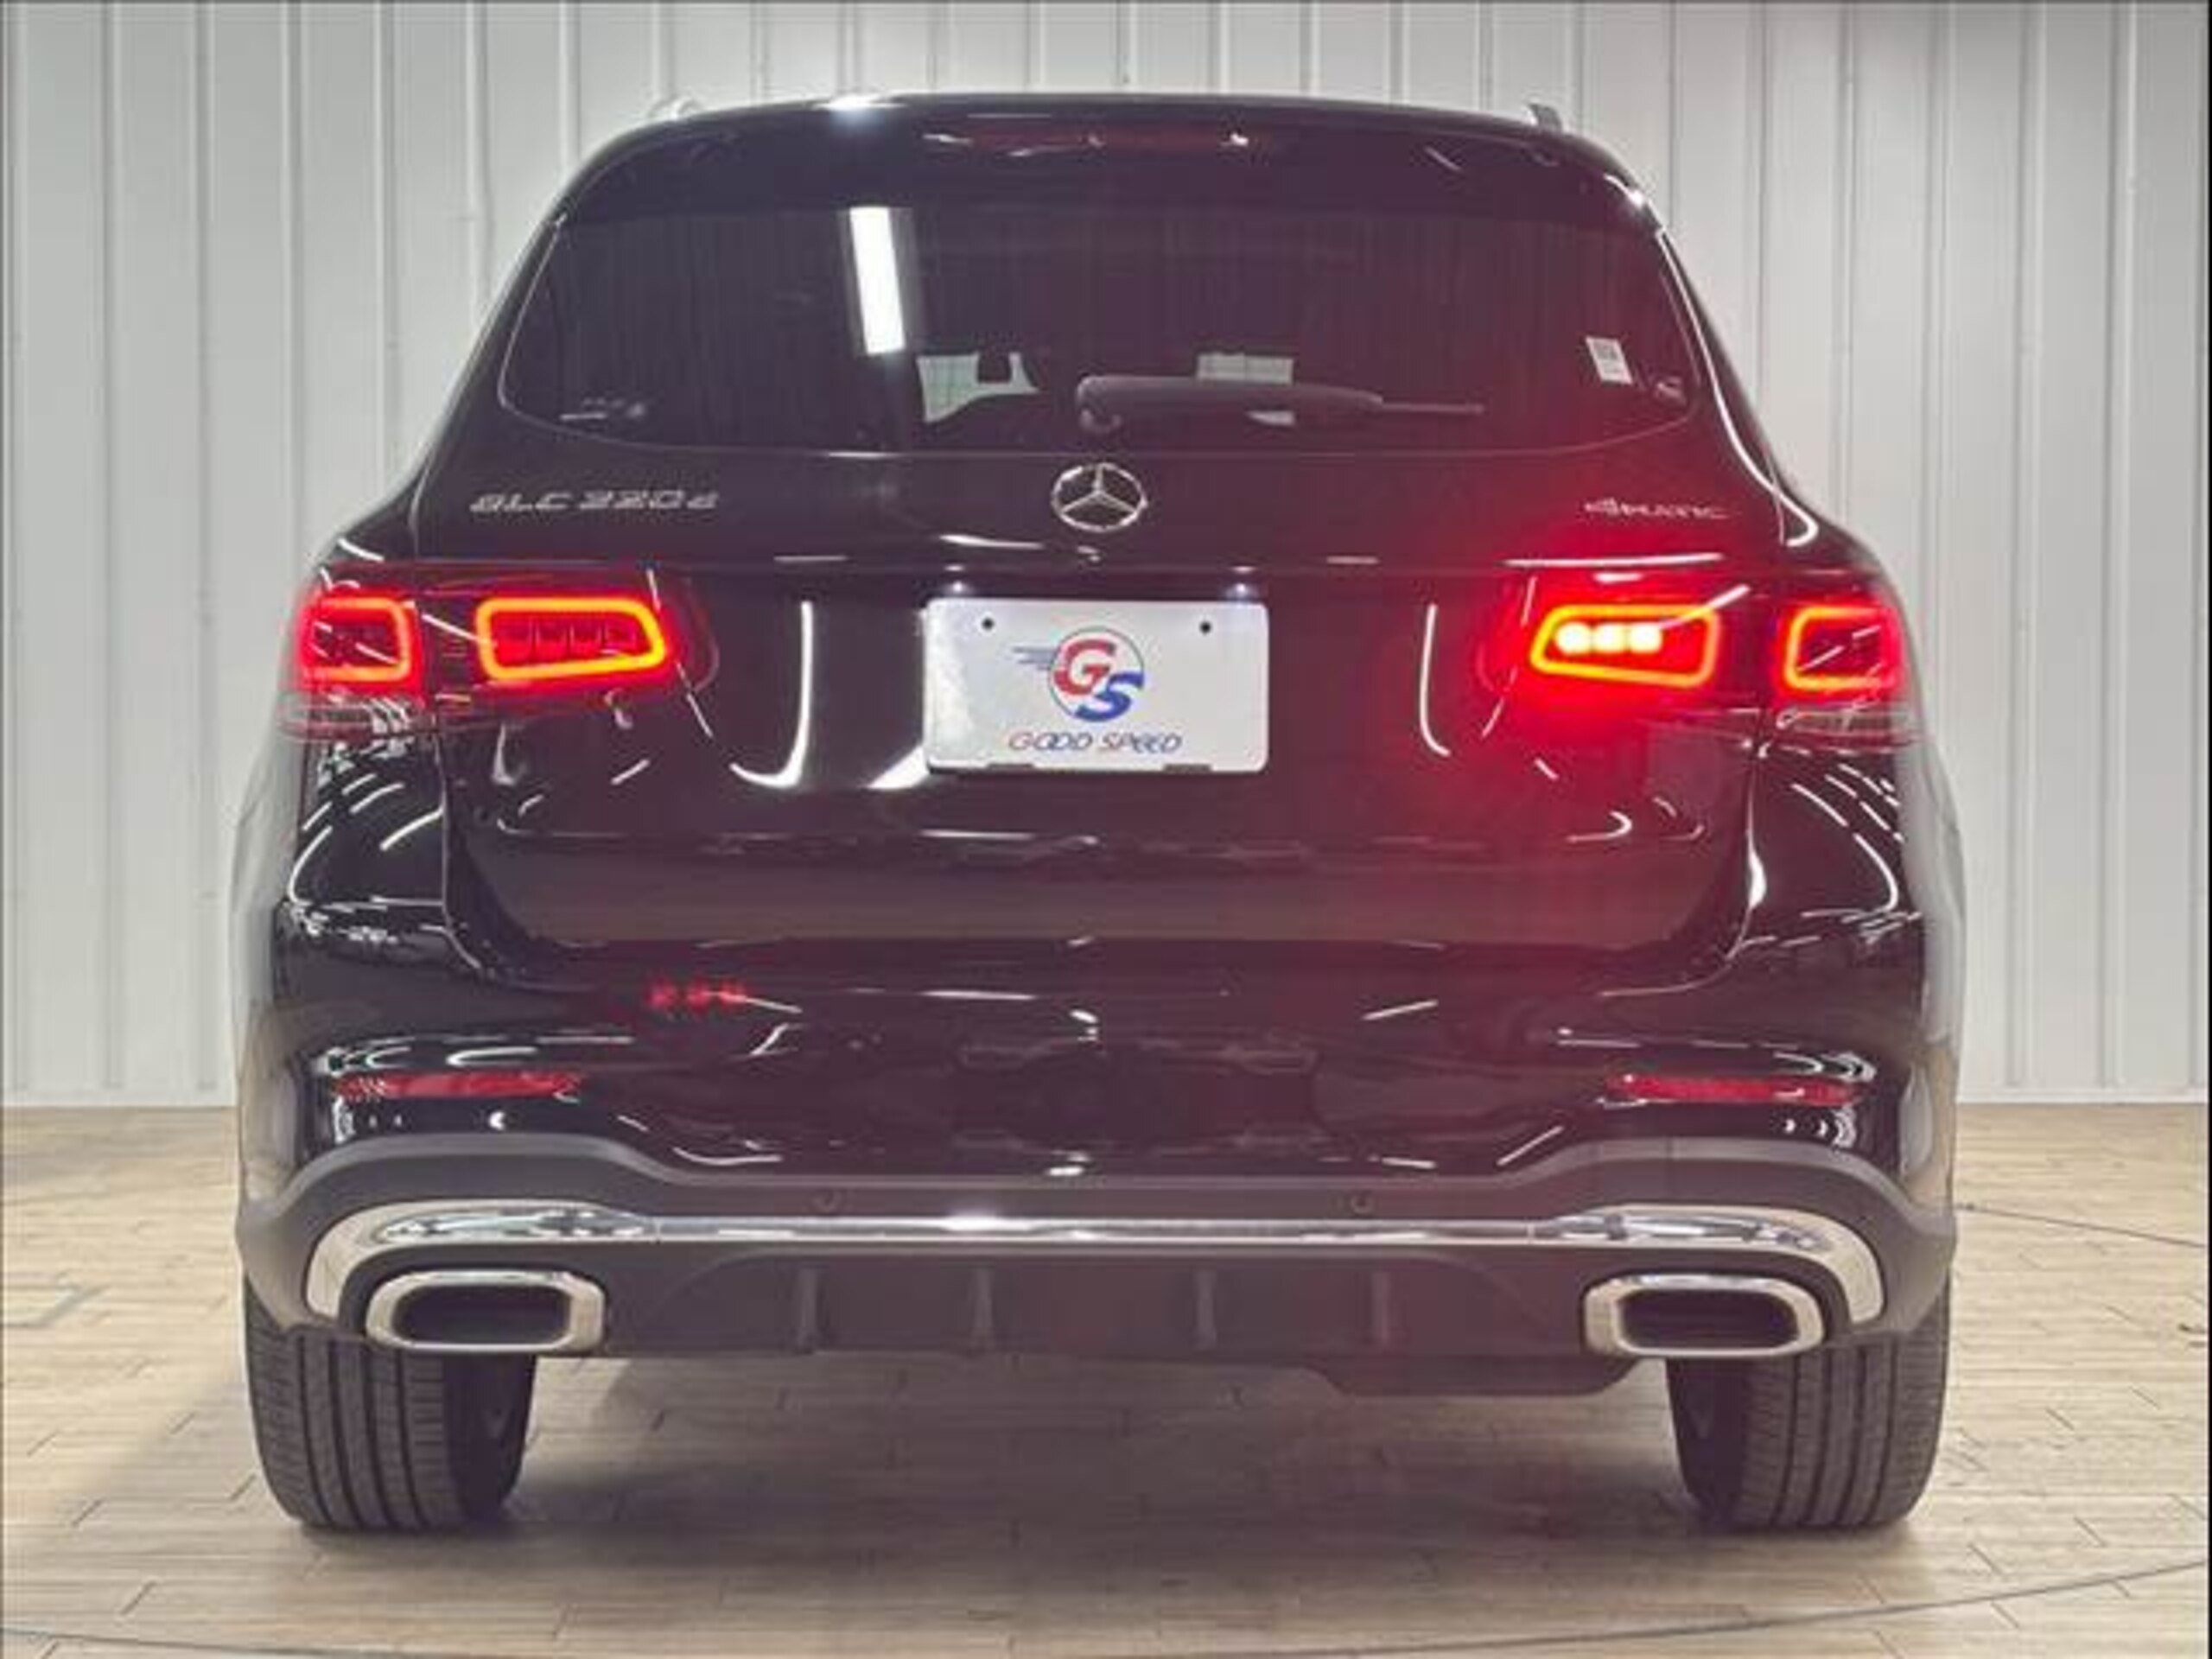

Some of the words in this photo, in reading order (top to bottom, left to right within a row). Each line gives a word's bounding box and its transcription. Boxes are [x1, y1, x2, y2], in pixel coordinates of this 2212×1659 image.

[469, 493, 573, 512] GLC
[1007, 731, 1094, 753] GOOD
[1096, 731, 1183, 754] SPEED
